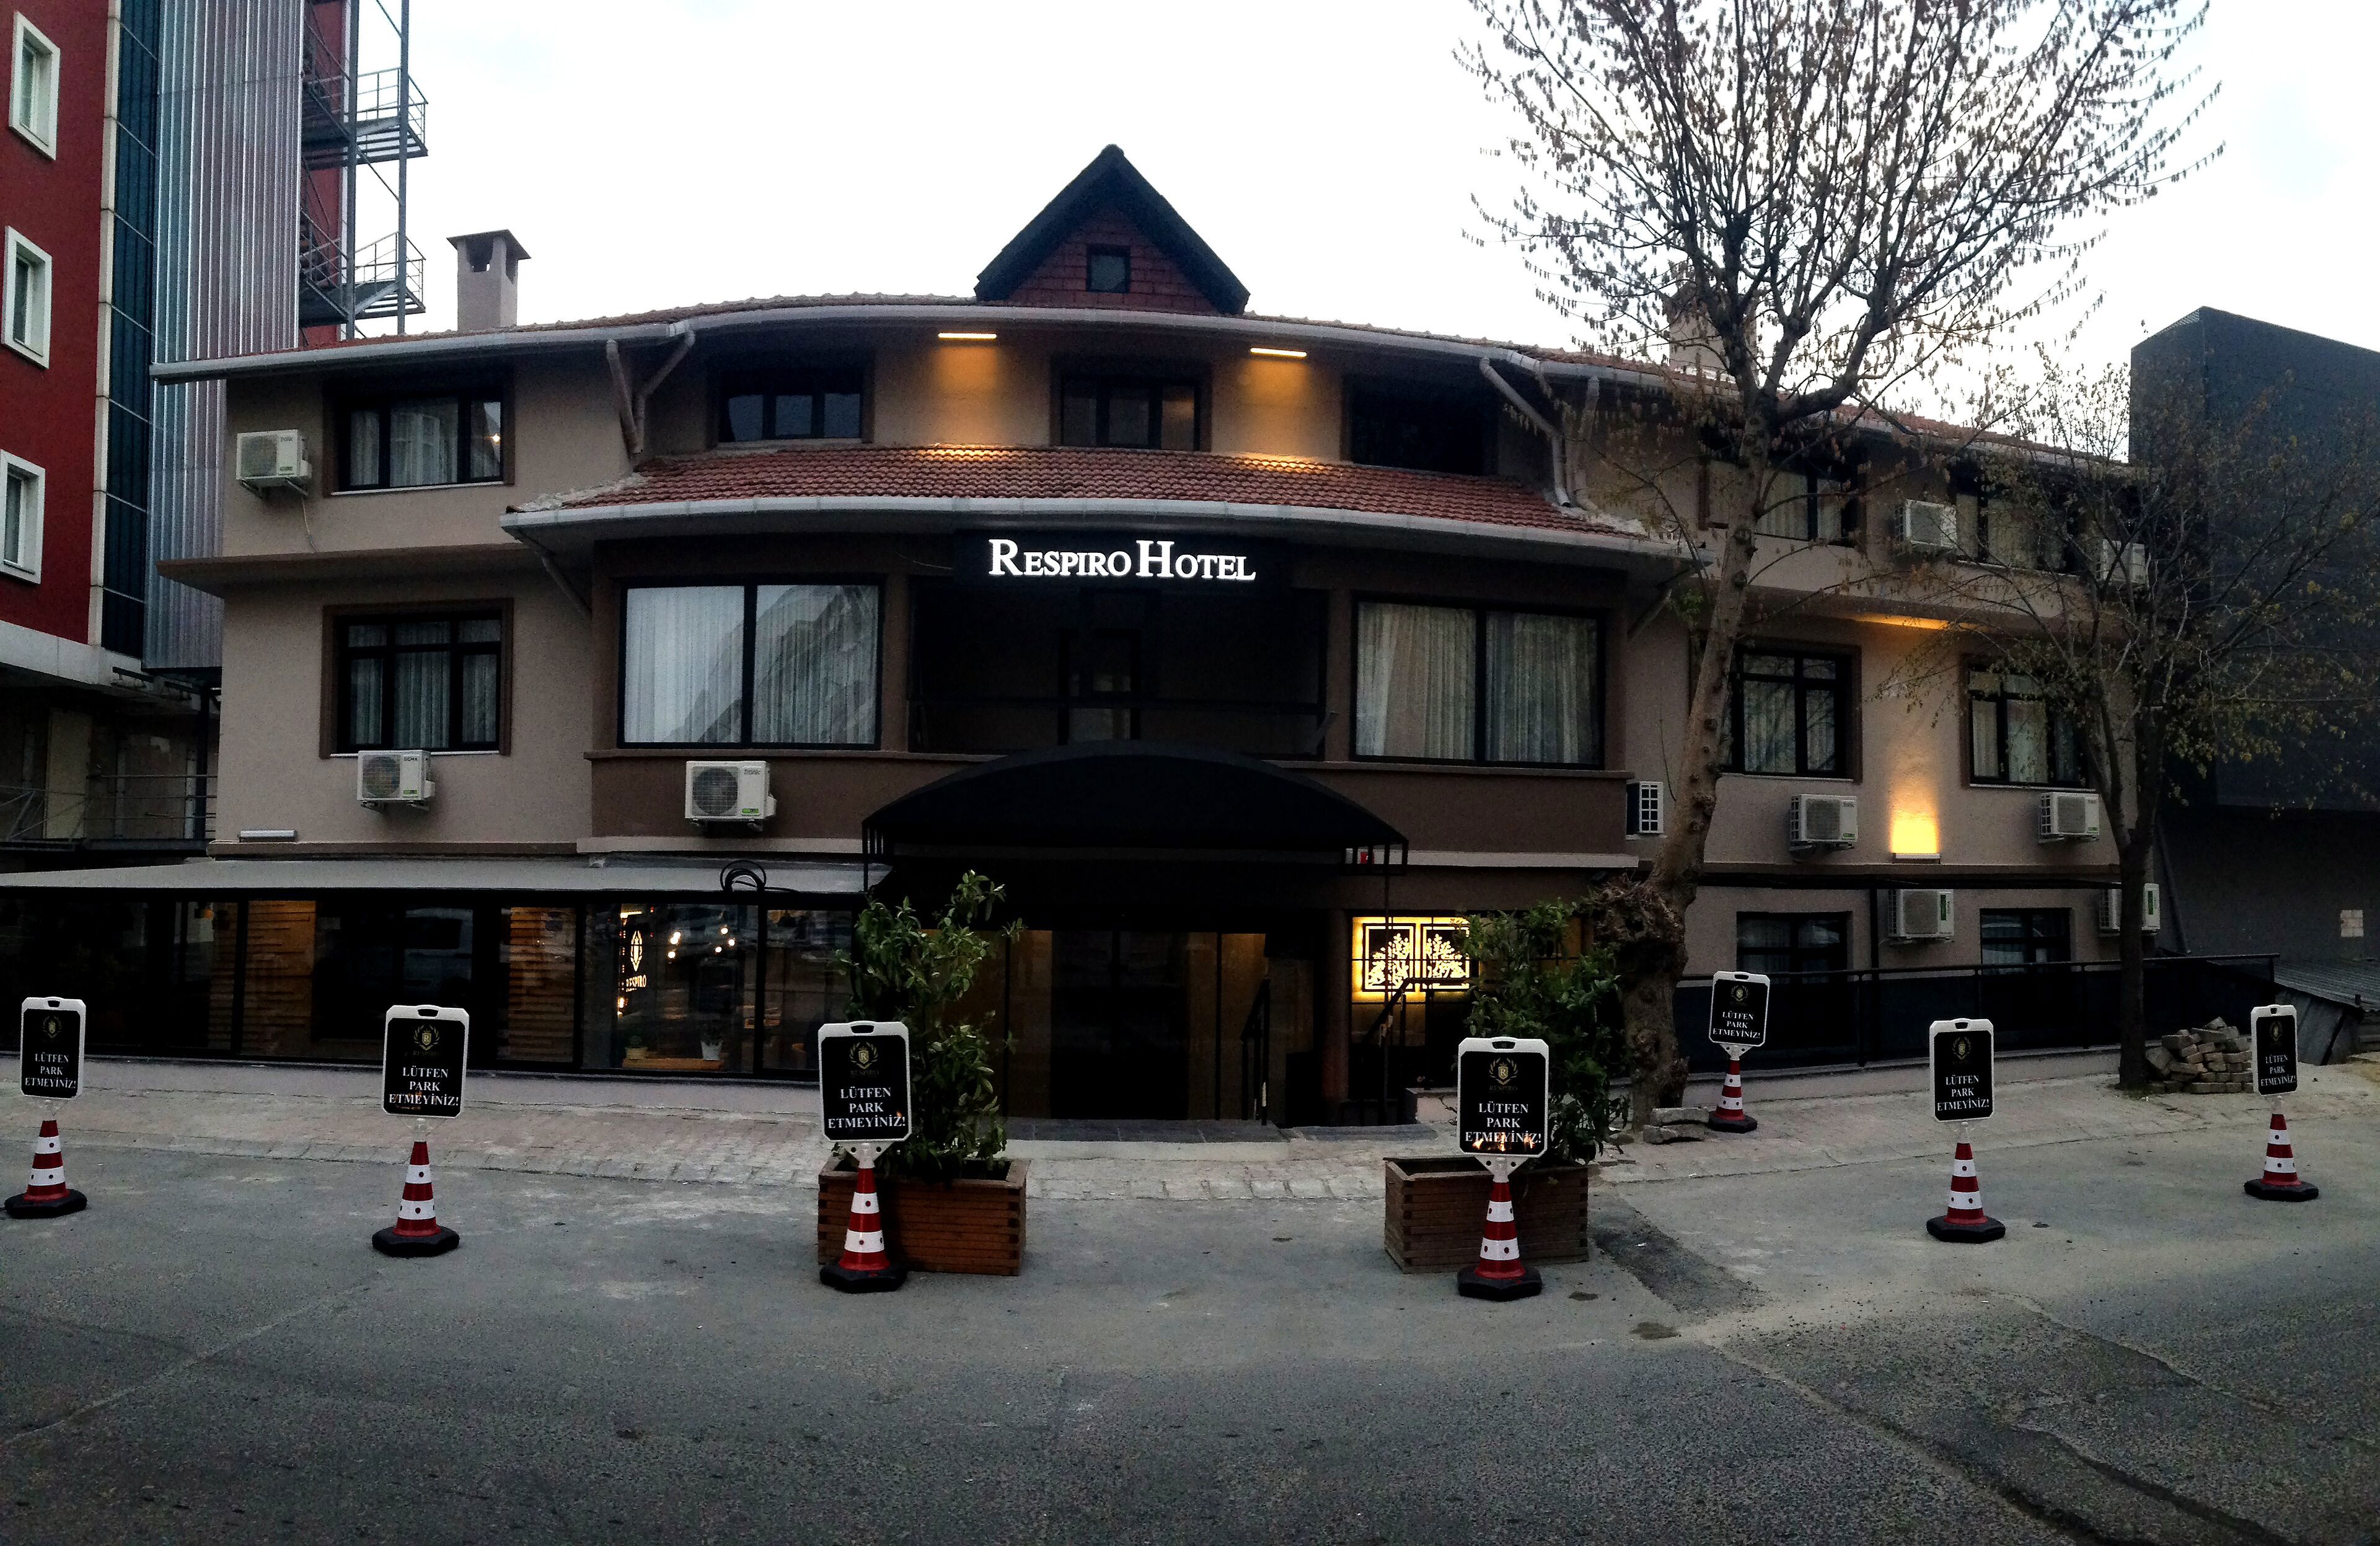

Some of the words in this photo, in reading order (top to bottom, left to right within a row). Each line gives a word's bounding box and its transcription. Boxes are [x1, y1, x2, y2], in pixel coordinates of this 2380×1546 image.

[988, 538, 1132, 576] RESPIRO
[1135, 539, 1256, 581] HOTEL
[1723, 1010, 1753, 1020] LÜTFEN
[1727, 1020, 1748, 1028] PARK
[1712, 1028, 1760, 1038] ETMEYİNİZ!
[35, 1052, 69, 1063] LÜTFEN
[40, 1066, 63, 1076] PARK
[403, 1066, 449, 1078] LÜTFEN
[2270, 1066, 2285, 1074] PARK
[25, 1077, 76, 1089] ETMEYİNİZ!
[1946, 1074, 1979, 1085] LÜTFEN
[410, 1081, 440, 1091] PARK
[840, 1086, 891, 1098] LÜTFEN
[1952, 1087, 1974, 1097] PARK
[389, 1093, 459, 1106] ETMEYİNİZ!
[1937, 1097, 1989, 1111] ETMEYİNİZ!
[848, 1102, 884, 1113] PARK
[1478, 1101, 1529, 1113] LÜTFEN
[827, 1115, 906, 1129] ETMEYİNİZ!
[1486, 1118, 1521, 1128] PARK
